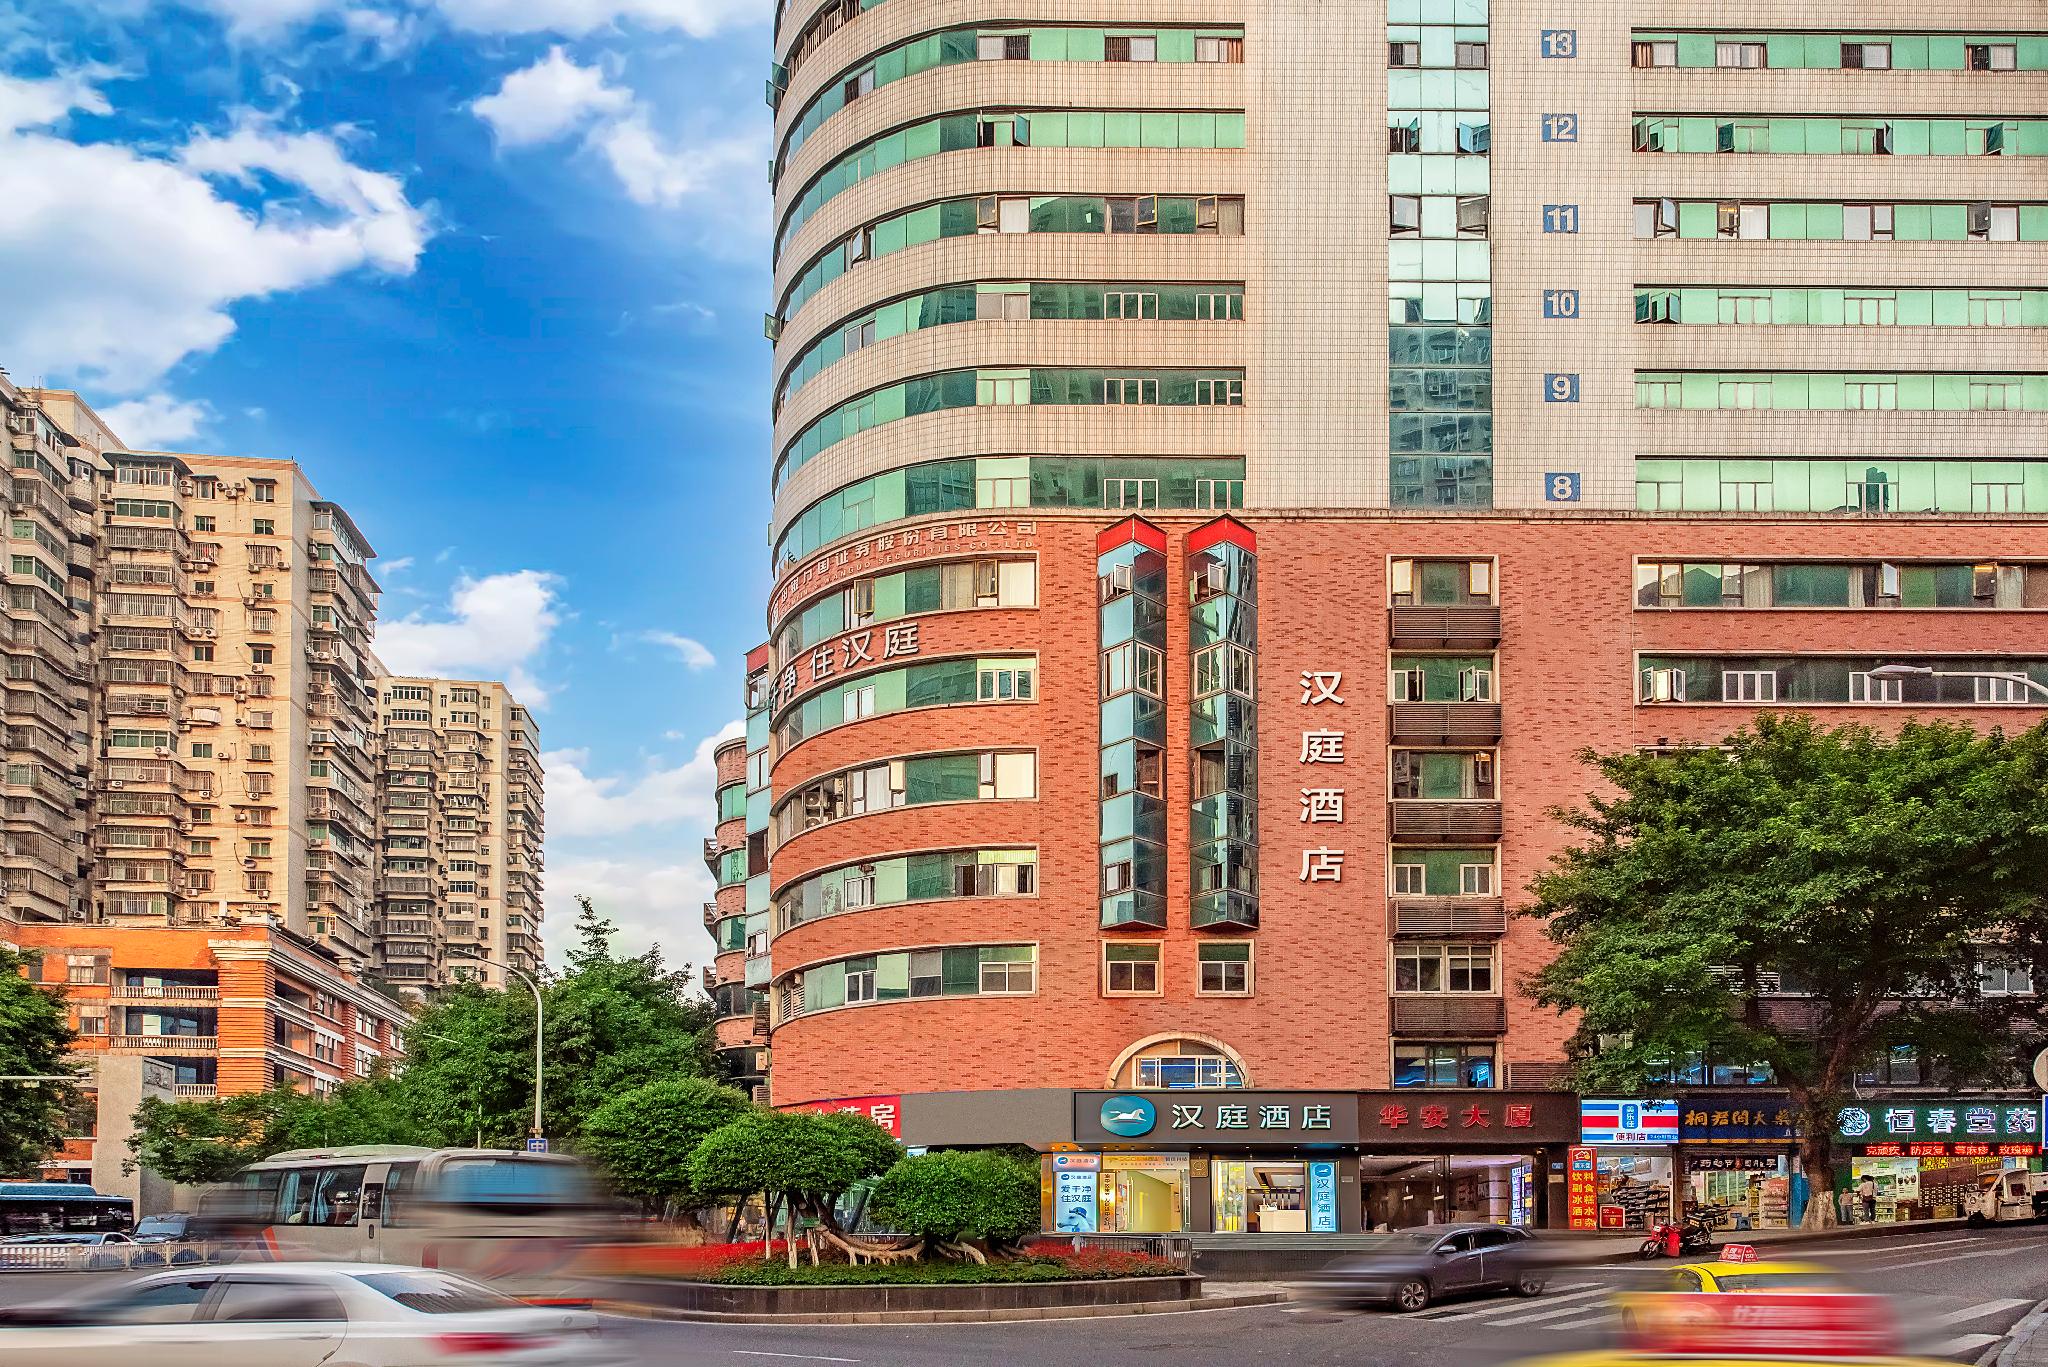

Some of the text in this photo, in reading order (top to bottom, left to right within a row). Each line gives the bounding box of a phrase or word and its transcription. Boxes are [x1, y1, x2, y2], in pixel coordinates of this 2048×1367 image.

[1543, 32, 1574, 57] 13
[1545, 116, 1576, 140] 12
[1547, 207, 1575, 231] 11
[1547, 291, 1576, 317] 10
[1552, 376, 1572, 400] 9
[1552, 475, 1573, 500] 8
[878, 543, 962, 564] SECURITIES
[1299, 669, 1345, 883] 汉庭酒店
[1171, 1103, 1332, 1130] 汉庭酒店
[1379, 1103, 1534, 1130] 华安大厦
[1884, 1107, 2038, 1134] 恒春堂药
[1615, 1132, 1647, 1141] 便利店
[1060, 1184, 1092, 1193] 爱干净
[1571, 1171, 1595, 1182] 饮料
[1572, 1183, 1595, 1193] 副食
[1060, 1194, 1093, 1203] 住汉庭
[1316, 1178, 1331, 1226] 汉庭酒店
[1572, 1195, 1595, 1205] 冰糕
[1572, 1206, 1595, 1216] 酒水
[1573, 1218, 1595, 1228] 日杂
